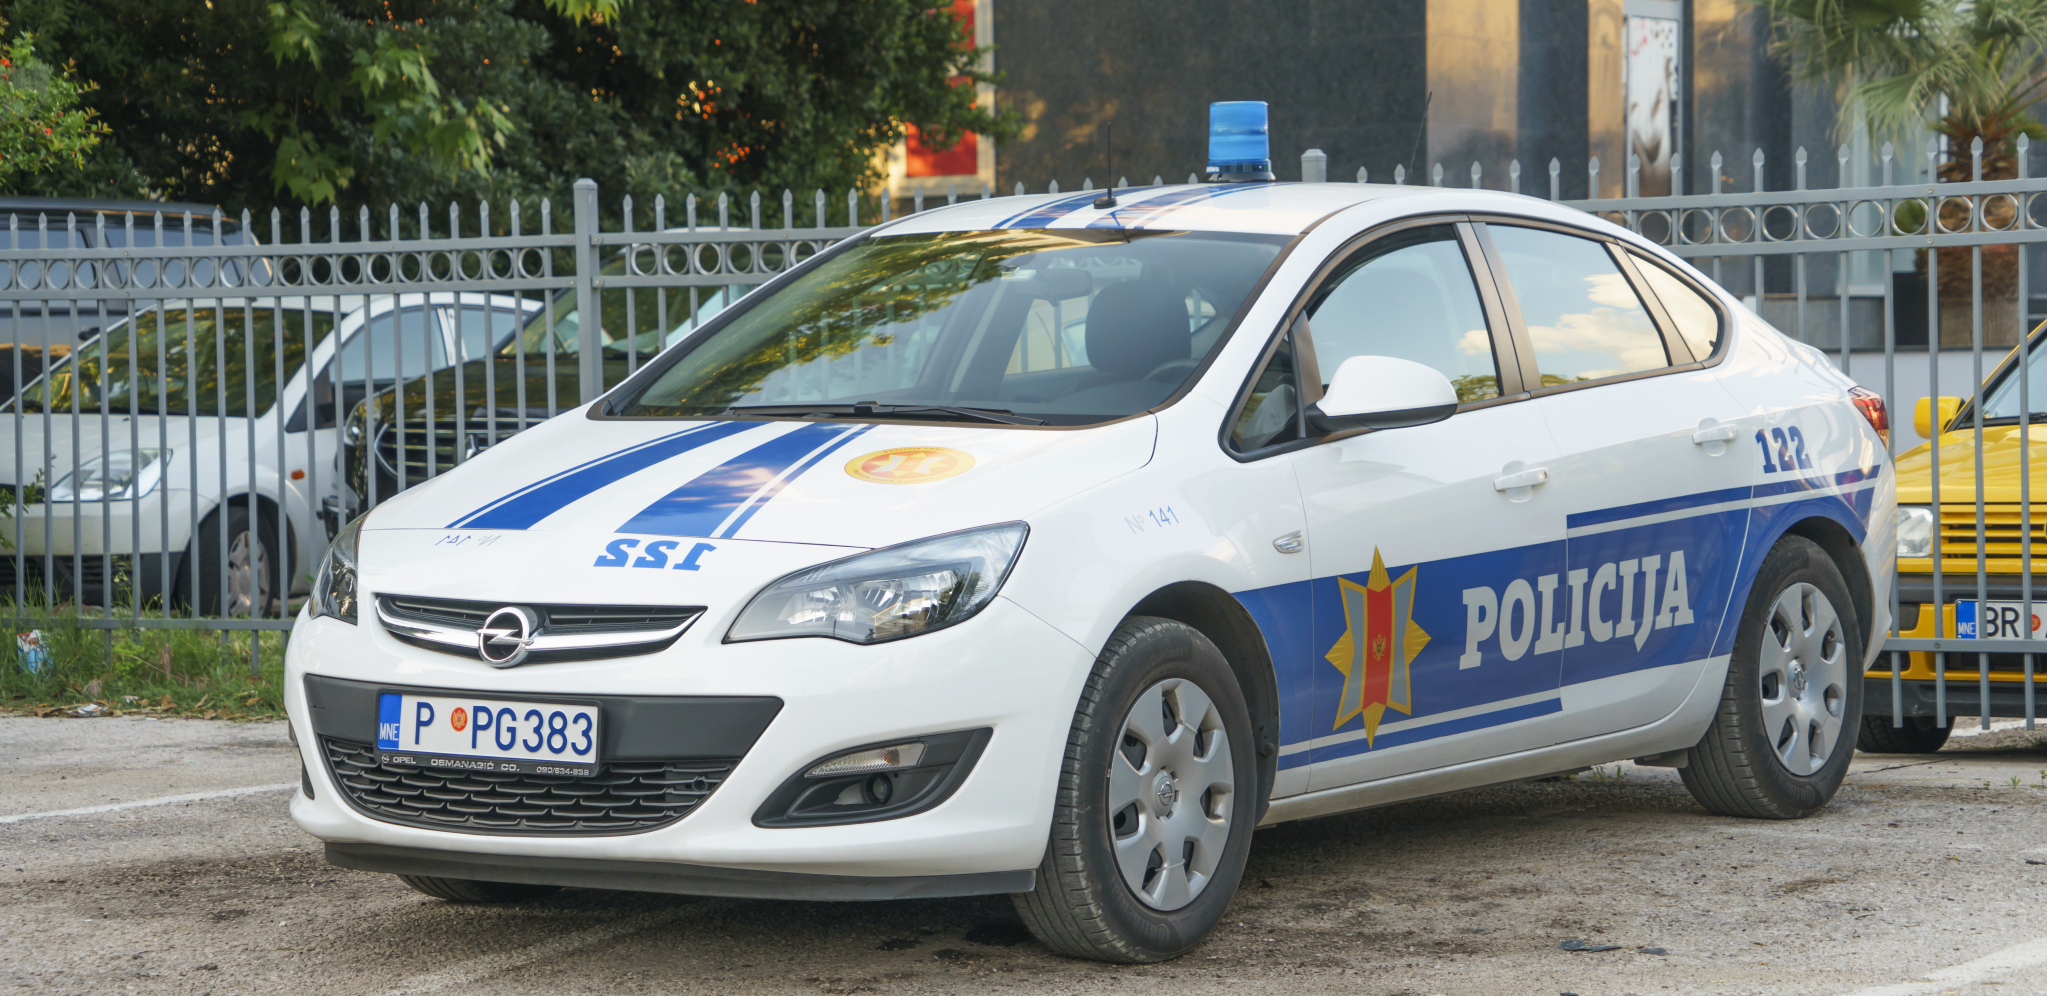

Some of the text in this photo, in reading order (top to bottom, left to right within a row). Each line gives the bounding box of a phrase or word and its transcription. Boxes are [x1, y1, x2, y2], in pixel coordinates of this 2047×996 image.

[1755, 425, 1813, 474] 122
[1149, 505, 1180, 528] 141
[1459, 550, 1695, 670] POLICIJA
[1986, 606, 2020, 638] BR
[1957, 622, 1976, 635] MNE
[379, 722, 399, 742] MNE
[414, 701, 435, 745] P
[393, 756, 417, 764] OPEL
[500, 763, 520, 772] CO.
